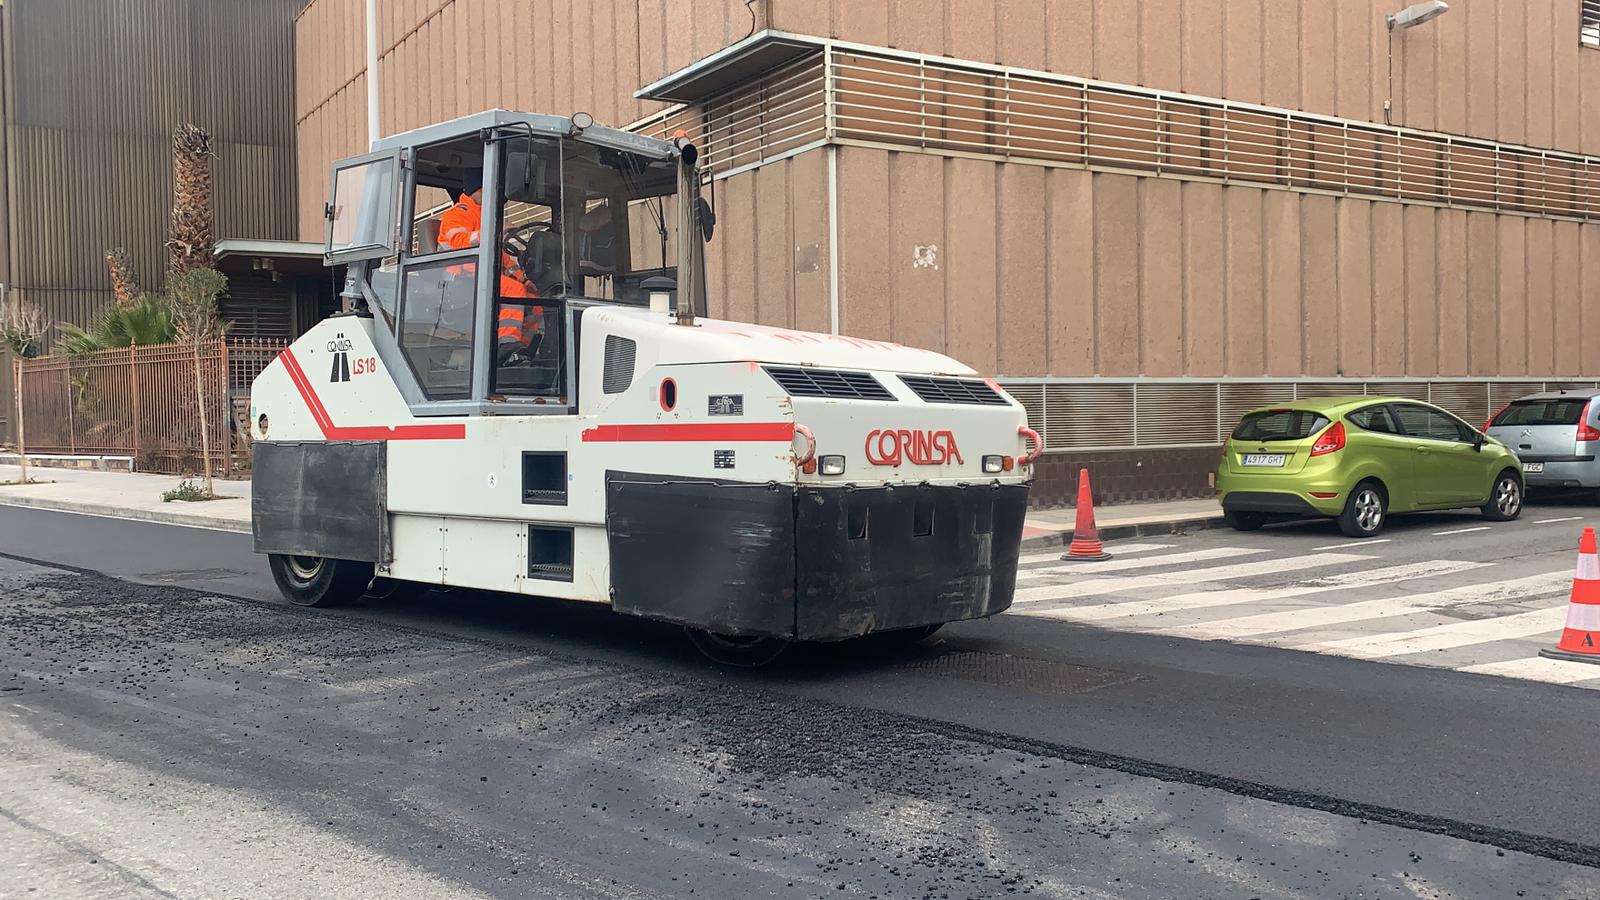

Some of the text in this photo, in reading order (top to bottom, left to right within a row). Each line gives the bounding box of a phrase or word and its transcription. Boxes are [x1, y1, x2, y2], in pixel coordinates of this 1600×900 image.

[353, 357, 376, 375] LS18
[865, 429, 964, 465] CORINSA
[1581, 632, 1594, 647] A
